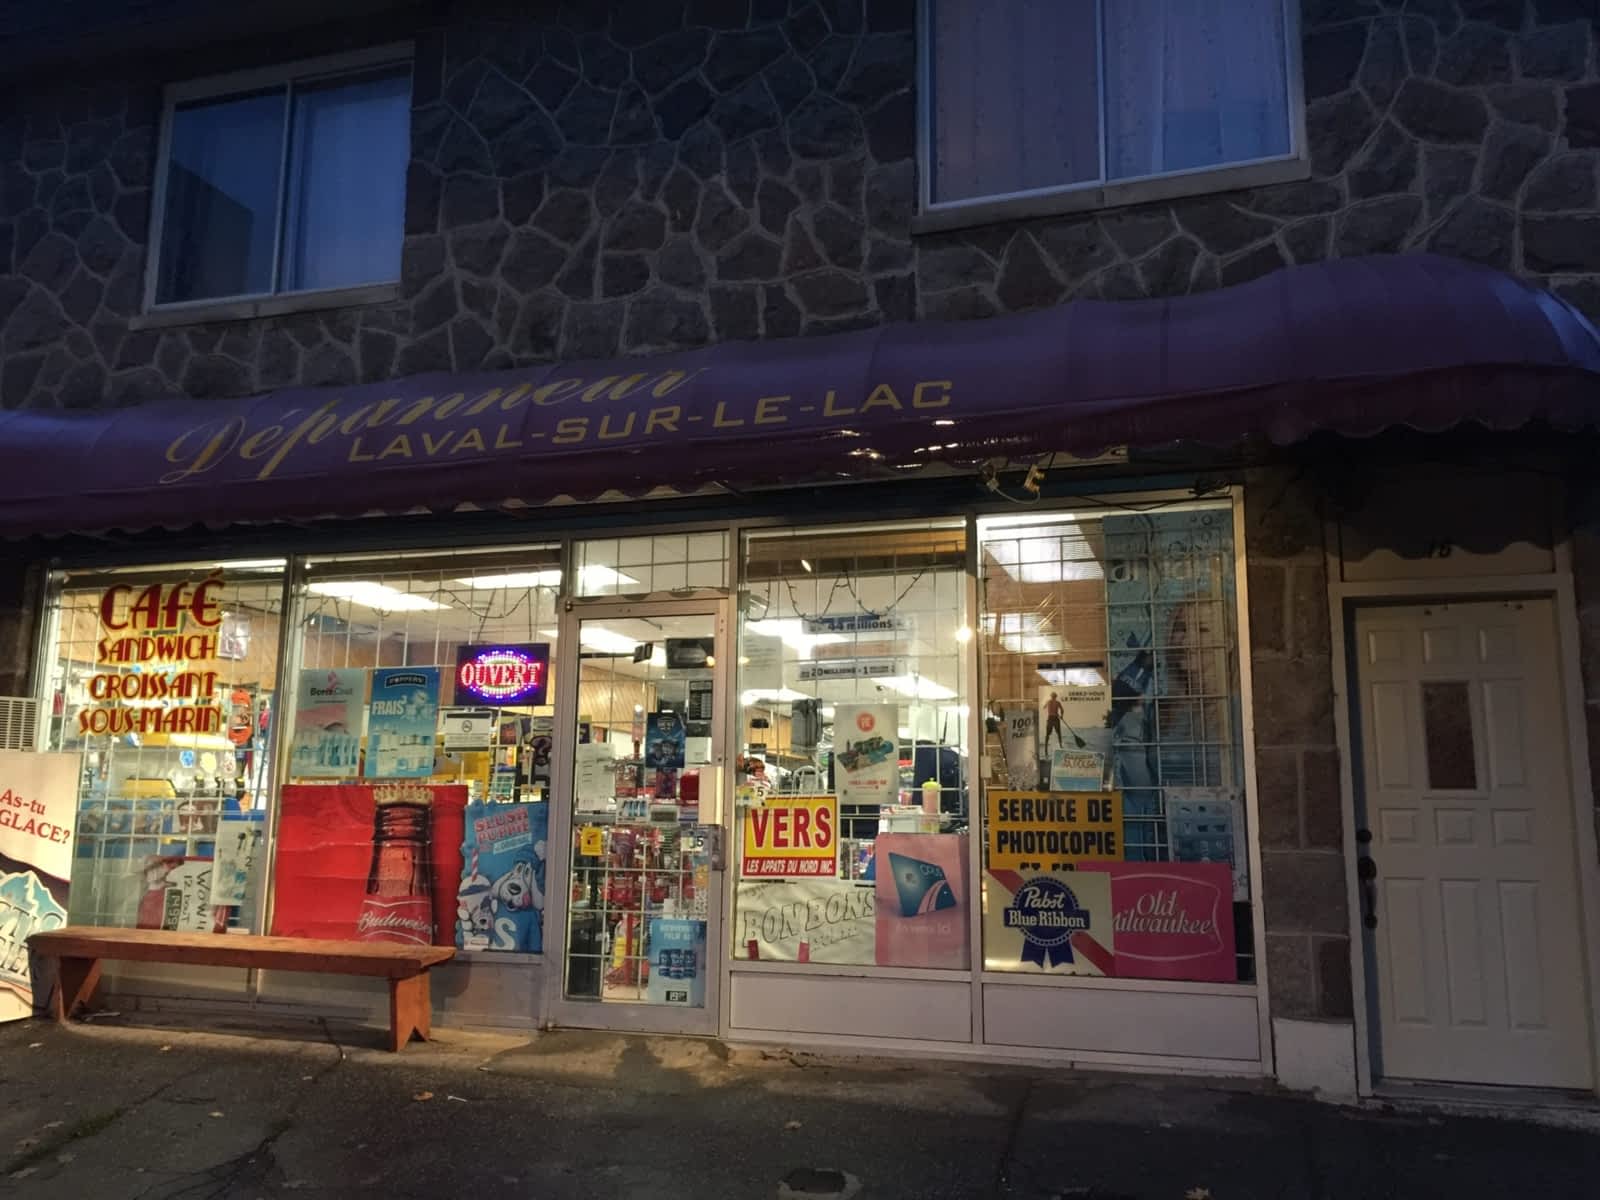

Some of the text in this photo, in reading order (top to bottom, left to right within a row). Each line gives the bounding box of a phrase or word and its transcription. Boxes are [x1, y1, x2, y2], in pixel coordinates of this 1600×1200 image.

[160, 367, 711, 484] Dépanneur
[348, 380, 955, 463] LAVAL-SUR-LE-LAC
[97, 634, 217, 663] SANDWICH
[89, 671, 219, 702] CROISSANT
[460, 662, 541, 687] OUVERT
[79, 706, 222, 736] SOUS-MARIN
[0, 789, 46, 815] As-tu
[998, 798, 1113, 823] SERVICE DE
[0, 809, 71, 845] GLACE?
[475, 807, 529, 833] SLUSH
[750, 806, 832, 849] VERS
[997, 830, 1116, 855] PHOTOCOPIE
[746, 860, 833, 874] LES APPATS DU NORD INC.
[1024, 886, 1065, 909] Pabst
[1136, 890, 1178, 916] Old
[358, 908, 439, 933] Budweiser
[1008, 908, 1085, 928] Blue Ribbon
